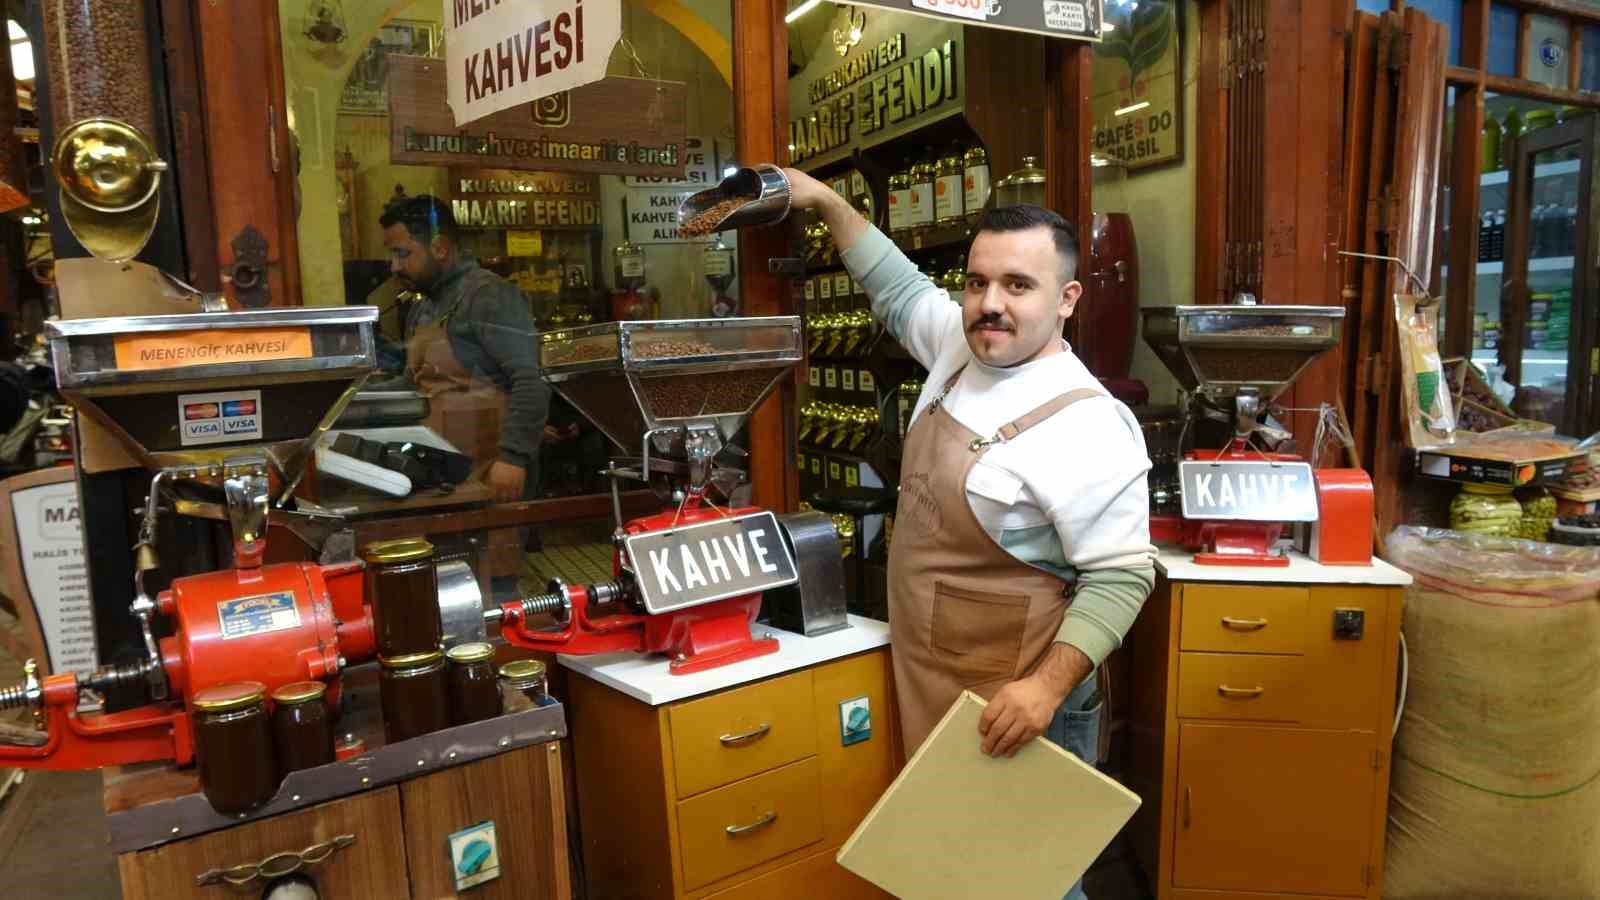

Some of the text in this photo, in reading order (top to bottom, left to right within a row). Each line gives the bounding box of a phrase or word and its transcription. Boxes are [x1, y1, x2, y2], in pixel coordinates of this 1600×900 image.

[465, 0, 584, 104] KAHVESİ
[1149, 110, 1171, 134] DO
[650, 195, 686, 207] KAHV
[631, 212, 676, 223] KAHVE
[140, 340, 287, 361] MENENGİÇ KAHVESİ
[191, 423, 218, 433] VISA
[228, 419, 255, 429] VISA
[1195, 473, 1300, 508] KAHVE
[649, 529, 778, 595] KAHVE
